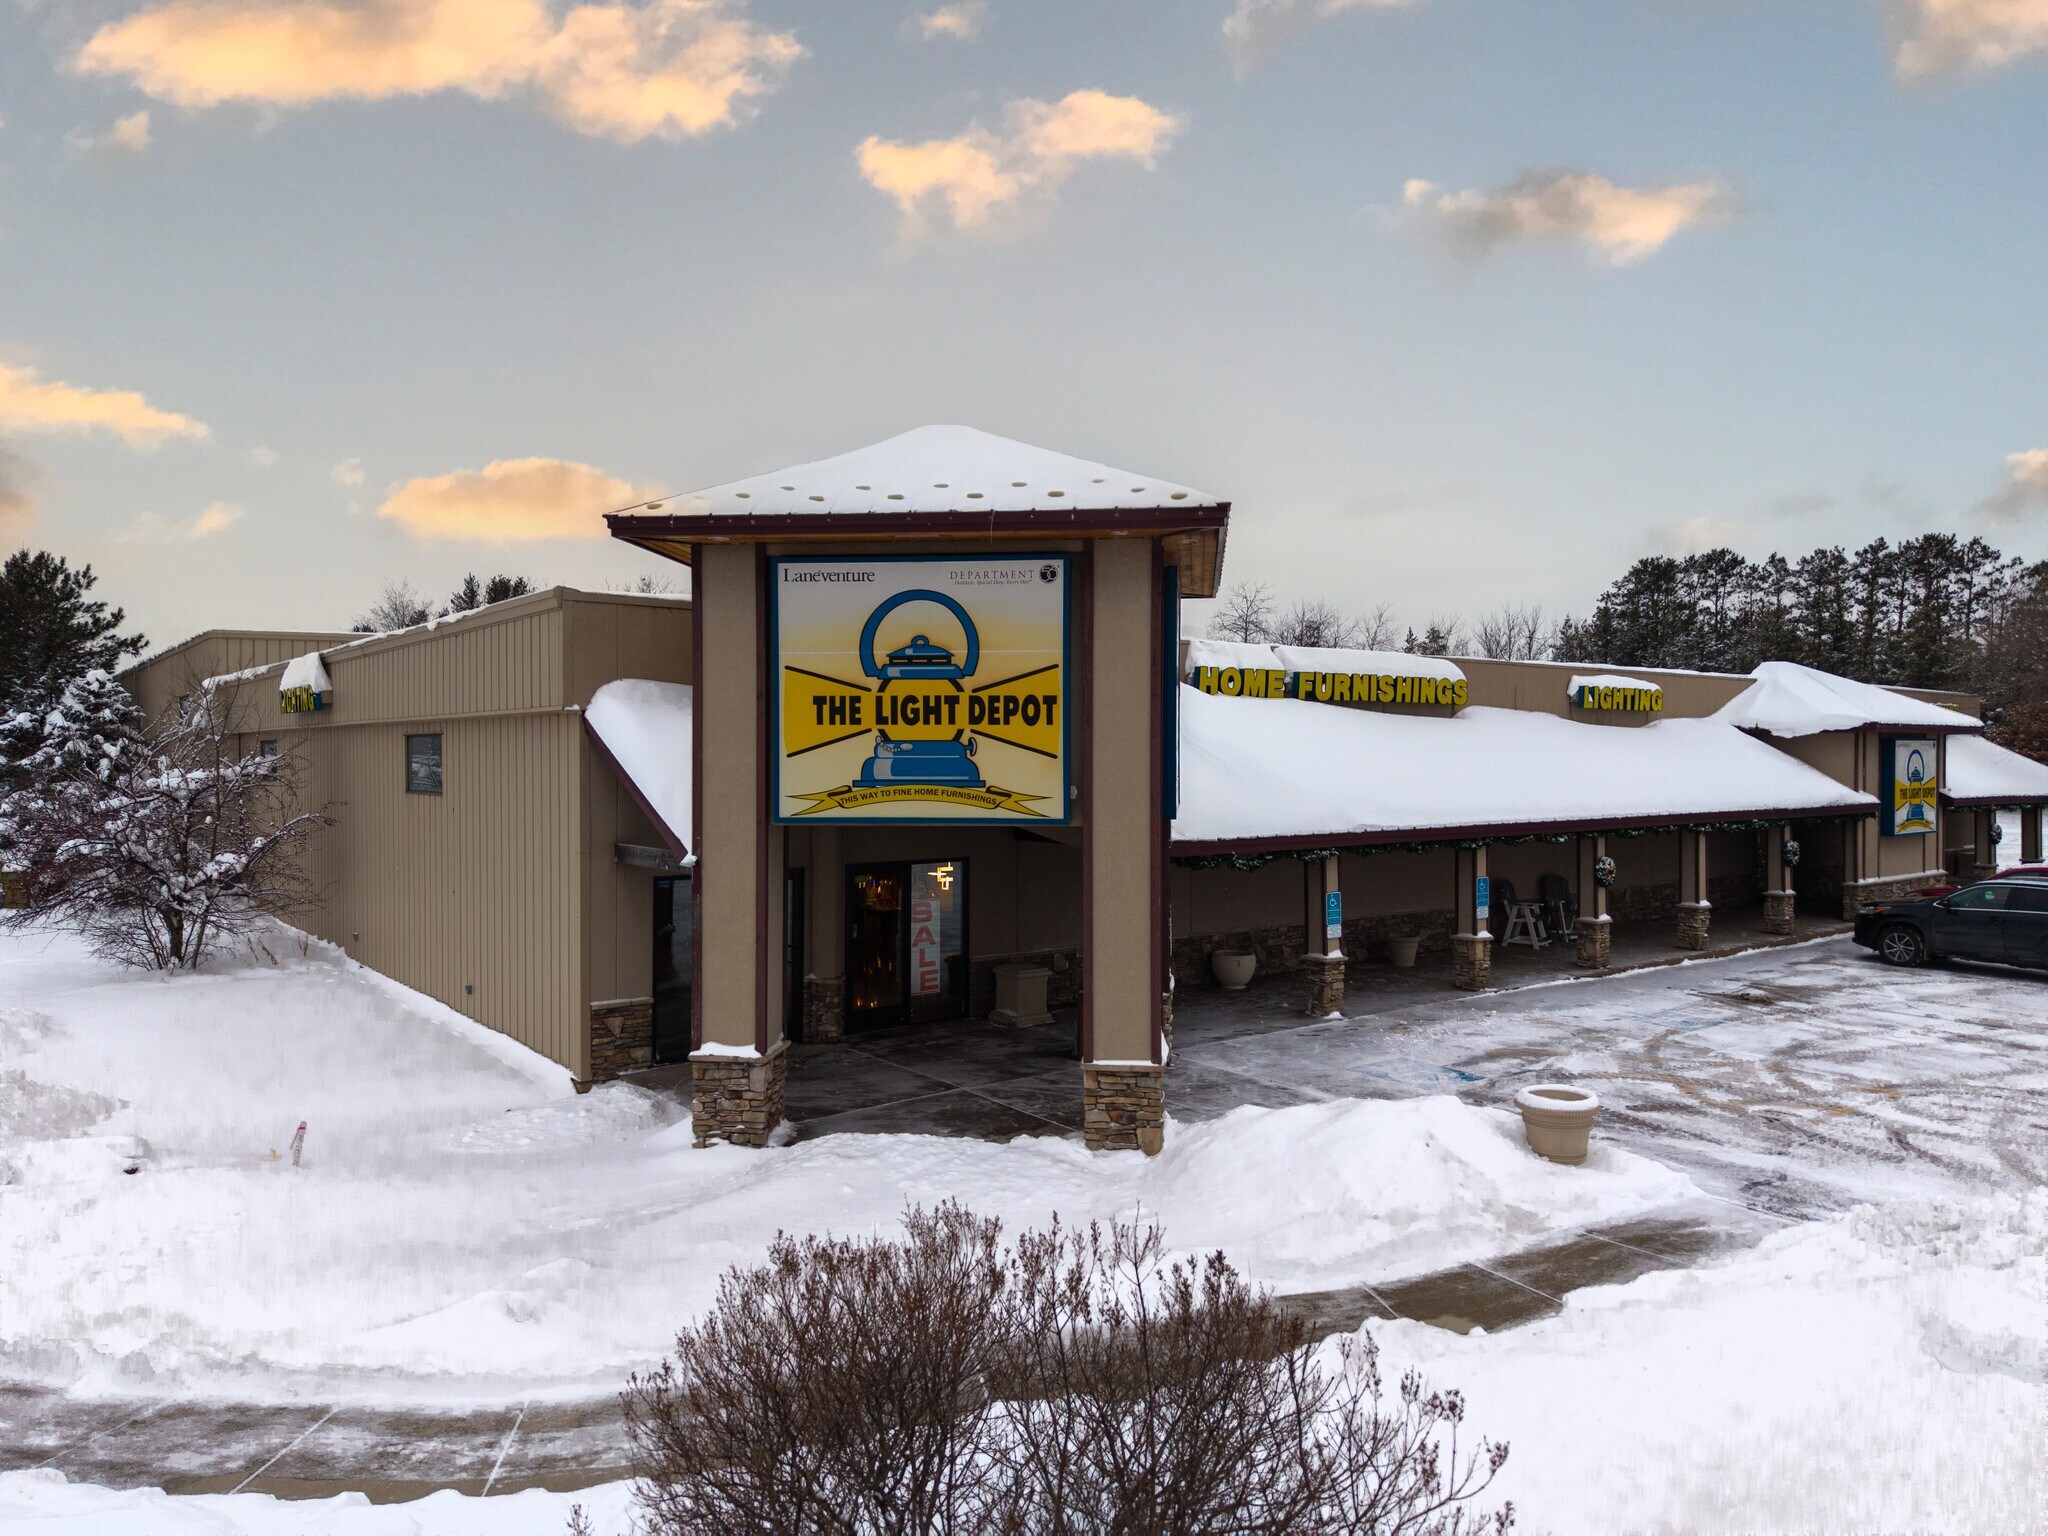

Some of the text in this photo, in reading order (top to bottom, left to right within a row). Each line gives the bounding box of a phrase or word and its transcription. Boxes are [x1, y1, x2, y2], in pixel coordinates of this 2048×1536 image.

[950, 570, 1035, 580] DEPARTMENT
[1199, 665, 1469, 706] HOME FURNISHINGS
[1582, 684, 1664, 712] LIGHTING
[812, 694, 1058, 727] THE LIGHT DEPOT
[840, 788, 998, 806] THIS WAY TO FINE HOME FURNISHINGS
[911, 901, 939, 992] SALE
